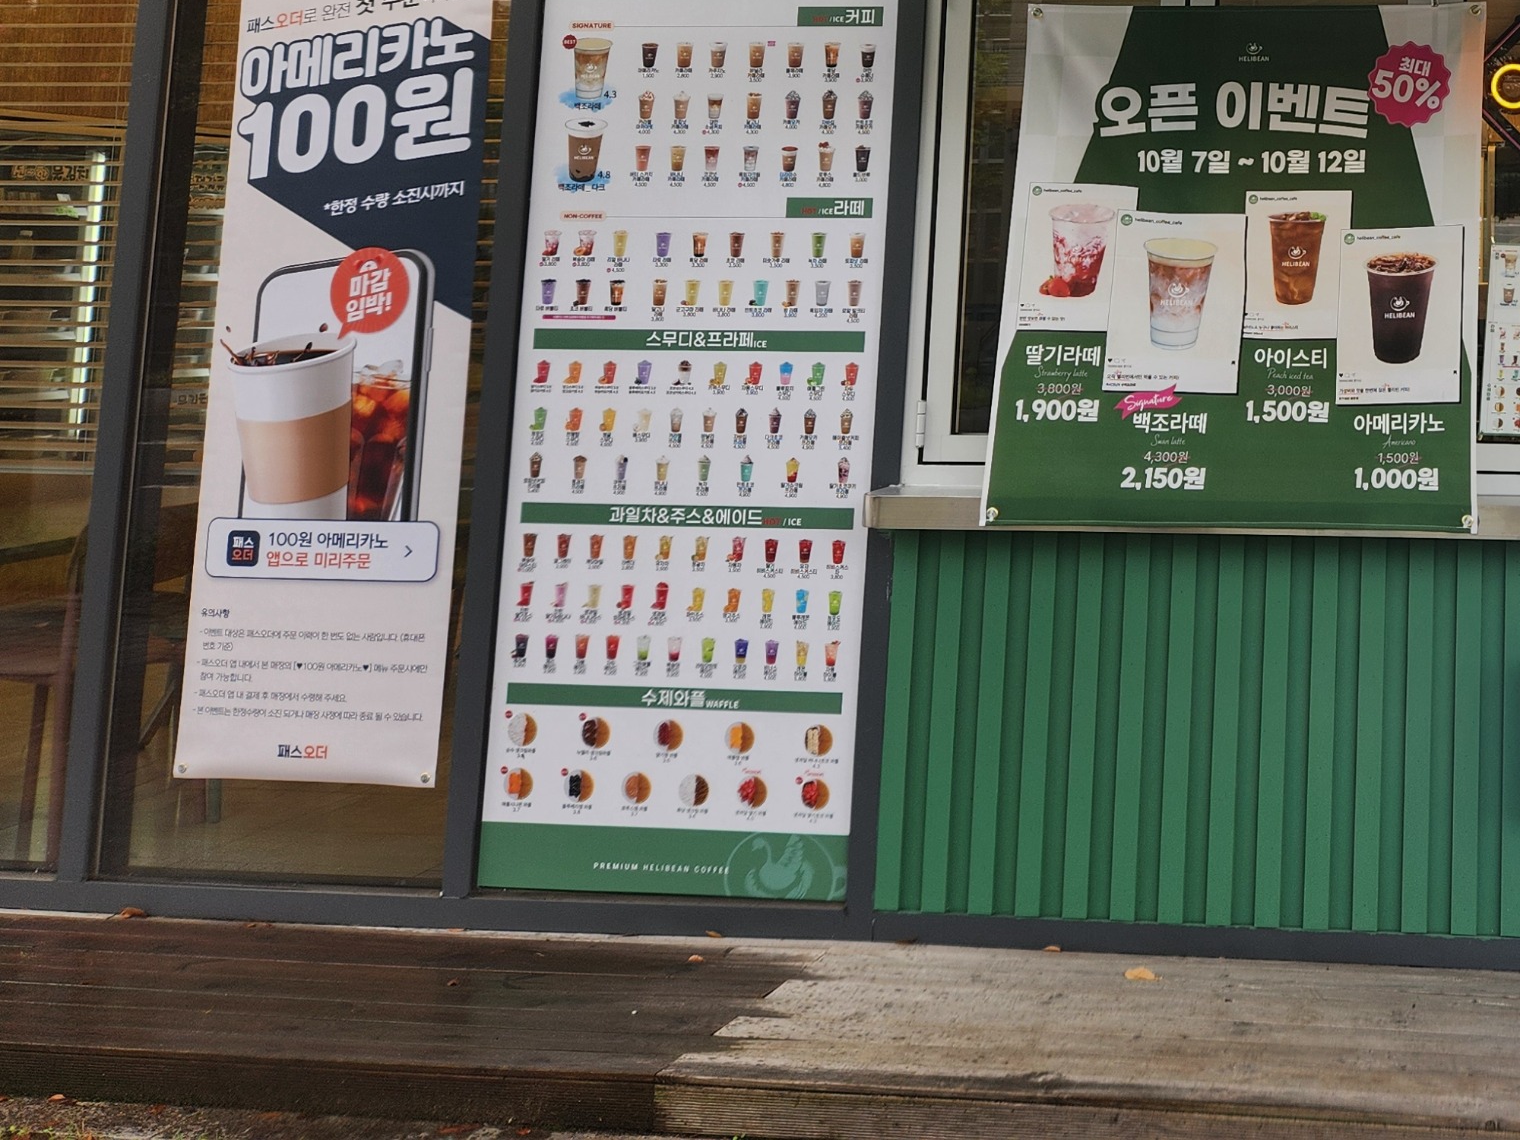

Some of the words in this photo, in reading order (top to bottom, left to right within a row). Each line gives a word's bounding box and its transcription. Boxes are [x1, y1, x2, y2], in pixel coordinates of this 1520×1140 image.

[247, 7, 317, 33] 패스오더로
[321, 2, 351, 23] 완전
[845, 8, 875, 25] 커피
[240, 16, 476, 97] 아메리카노
[1398, 57, 1431, 76] 최대
[603, 90, 617, 99] 4.3
[1372, 72, 1440, 110] 50%
[1099, 82, 1199, 138] 오픈
[1216, 81, 1370, 139] 이벤트
[238, 66, 475, 180] 100원
[1137, 149, 1183, 173] 10월
[1191, 150, 1230, 174] 7일
[1261, 150, 1310, 174] 10월
[1317, 149, 1366, 173] 12일
[597, 171, 611, 179] 4.8
[360, 192, 388, 210] 수량
[392, 180, 465, 206] 소진시까지
[834, 200, 865, 216] 라떼
[348, 268, 392, 297] 마감
[346, 292, 392, 322] 임박!
[646, 331, 754, 348] 스무디&프라페
[754, 339, 767, 348] ICE
[1026, 344, 1101, 367] 딸기라떼
[1254, 347, 1328, 369] 아이스티
[1267, 367, 1287, 380] Peach
[1288, 369, 1302, 380] iced
[1037, 383, 1082, 396] 3,800원
[1266, 384, 1312, 397] 3,000원
[1015, 398, 1099, 423] 1,900원
[1123, 394, 1174, 411] Signature
[1245, 400, 1330, 423] 1,500원
[1132, 412, 1207, 434] 백조라떼
[1353, 412, 1445, 435] 아메리카노
[1382, 435, 1416, 449] Americano
[1143, 451, 1189, 464] 4,300원
[1377, 451, 1419, 465] 1,500원
[1120, 467, 1206, 490] 2,150원
[1354, 467, 1439, 491] 1,000원
[609, 506, 763, 526] 과일차&주스&에이드
[232, 536, 254, 549] 패스
[268, 531, 313, 548] 100원
[317, 532, 389, 549] 아메리카노
[231, 549, 254, 561] 오더
[266, 551, 309, 567] 앱으로
[314, 552, 371, 570] 미리주문
[201, 607, 230, 619] 유의사항
[641, 688, 705, 708] 수제와플
[705, 699, 739, 710] WAFFLE
[277, 744, 328, 759] 패스오더
[593, 862, 638, 871] PREMIUM
[642, 863, 690, 873] HELIBEAN
[694, 864, 730, 875] COFFEE
